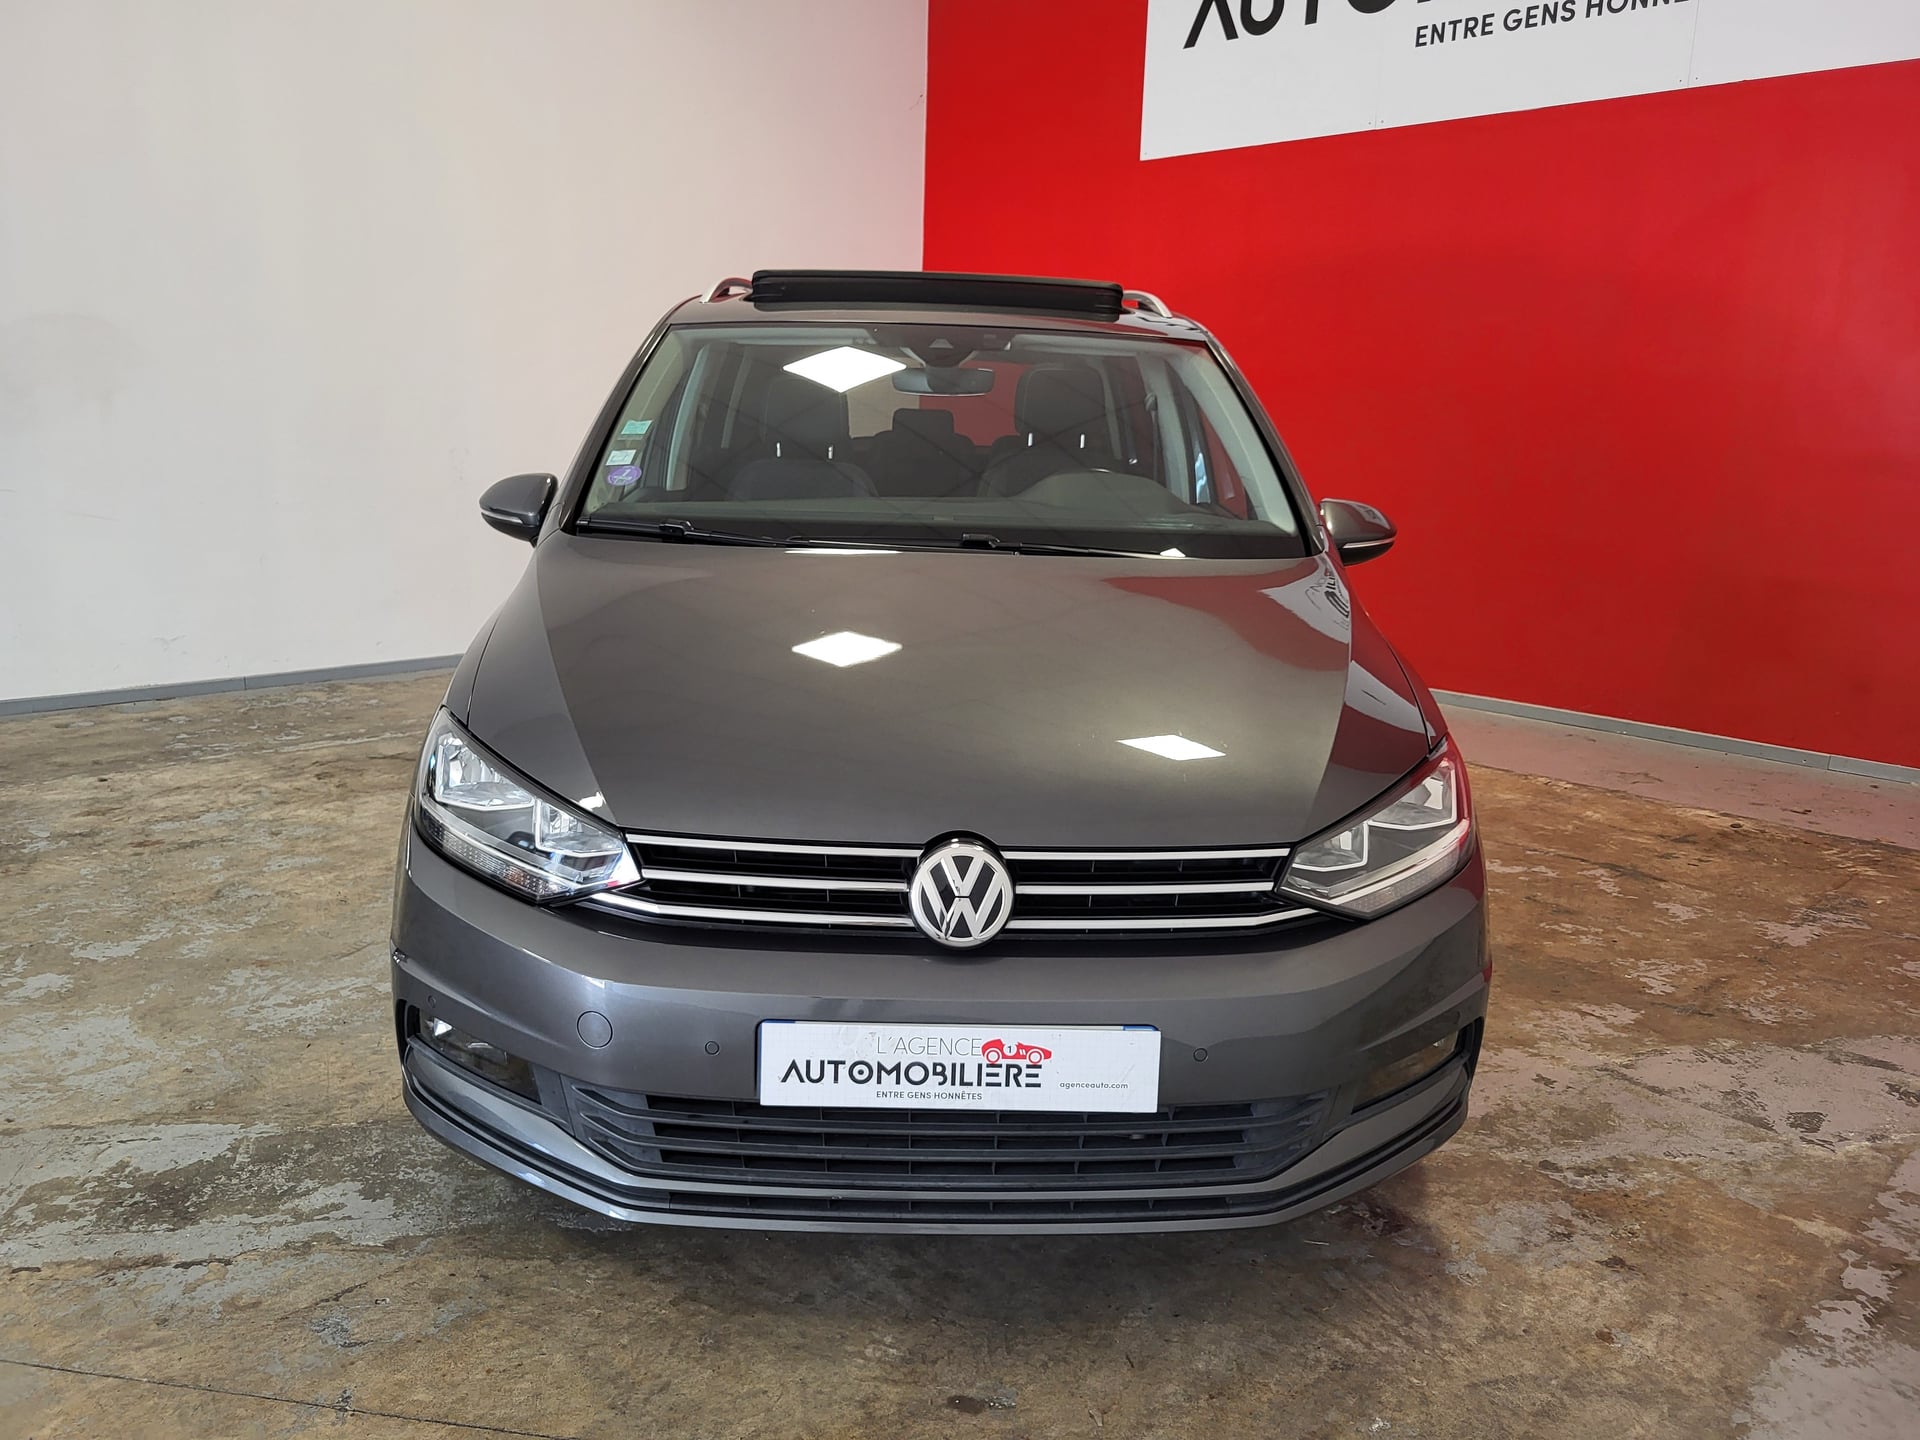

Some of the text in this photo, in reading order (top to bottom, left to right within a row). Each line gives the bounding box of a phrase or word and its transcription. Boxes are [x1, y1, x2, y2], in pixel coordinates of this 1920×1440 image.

[1415, 13, 1495, 48] ENTRE
[1503, 0, 1576, 32] GENS
[877, 1036, 982, 1056] L'AGENCE
[1059, 1082, 1129, 1090] agenceauto.com
[876, 1090, 982, 1100] ENTRE GENS HONNÊTES
